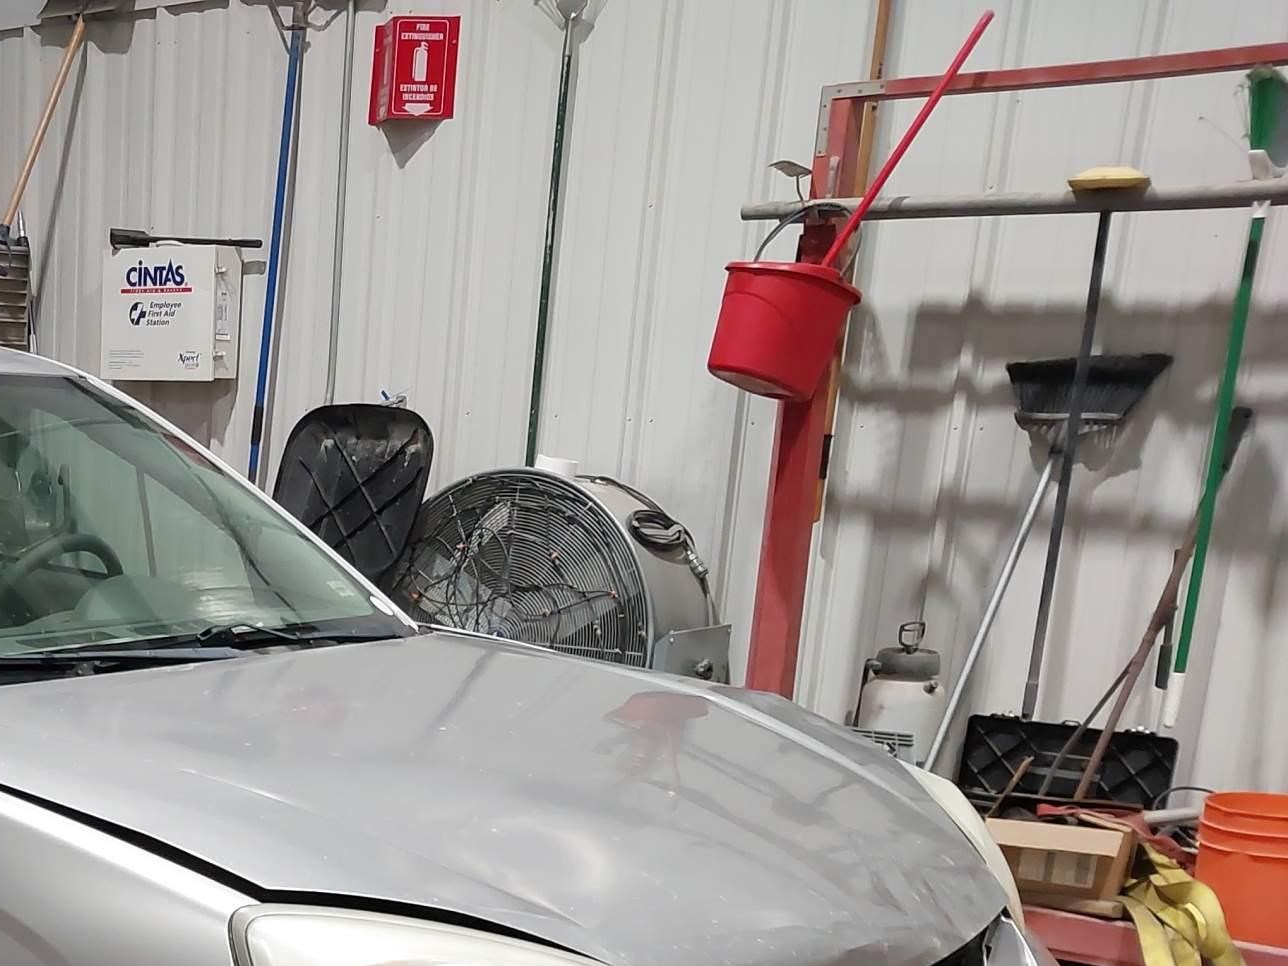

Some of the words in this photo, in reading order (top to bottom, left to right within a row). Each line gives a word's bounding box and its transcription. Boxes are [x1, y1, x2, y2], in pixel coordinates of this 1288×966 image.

[126, 258, 185, 287] CINTAS
[149, 301, 182, 311] Employee
[163, 309, 176, 317] Aid
